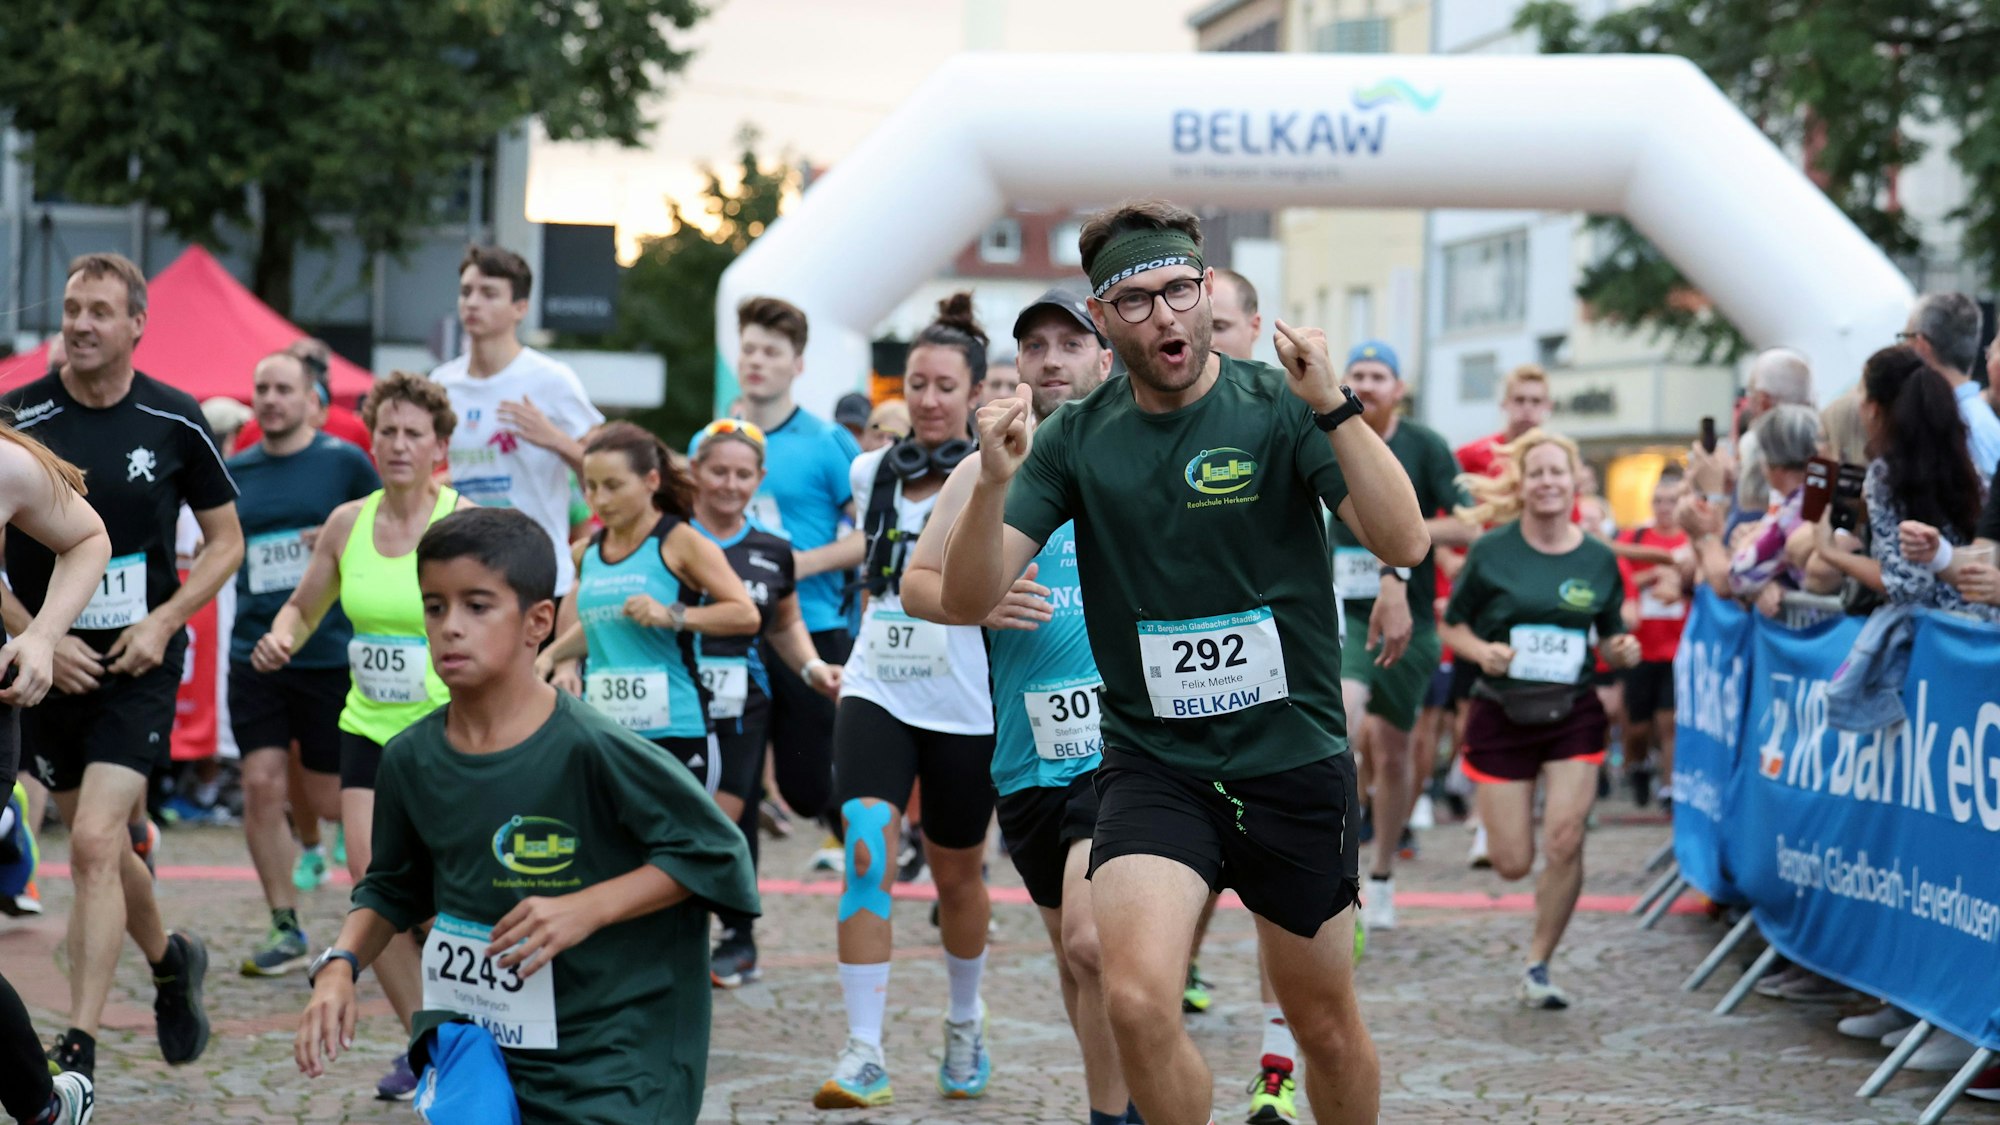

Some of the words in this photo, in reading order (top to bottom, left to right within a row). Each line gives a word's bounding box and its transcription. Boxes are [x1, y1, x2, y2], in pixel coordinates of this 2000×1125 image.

[1172, 109, 1387, 156] BELKAW
[1186, 498, 1222, 509] Realschule
[260, 543, 301, 565] 280
[102, 571, 125, 595] 11
[887, 626, 914, 648] 97
[1147, 624, 1157, 632] 27.
[1157, 622, 1188, 634] Bergisch
[1188, 618, 1231, 631] Gladbacher
[1172, 634, 1248, 673] 292
[1528, 632, 1568, 655] 364
[362, 646, 405, 672] 205
[877, 664, 932, 679] BELKAW
[1182, 679, 1206, 690] Felix
[1209, 675, 1243, 686] Mettke
[602, 677, 647, 701] 386
[1173, 686, 1261, 716] BELKAW
[1055, 727, 1083, 737] Stefan
[1829, 680, 1937, 814] Bank
[1824, 847, 1999, 943] Gladbach-Leverkusen
[437, 941, 524, 993] 2243
